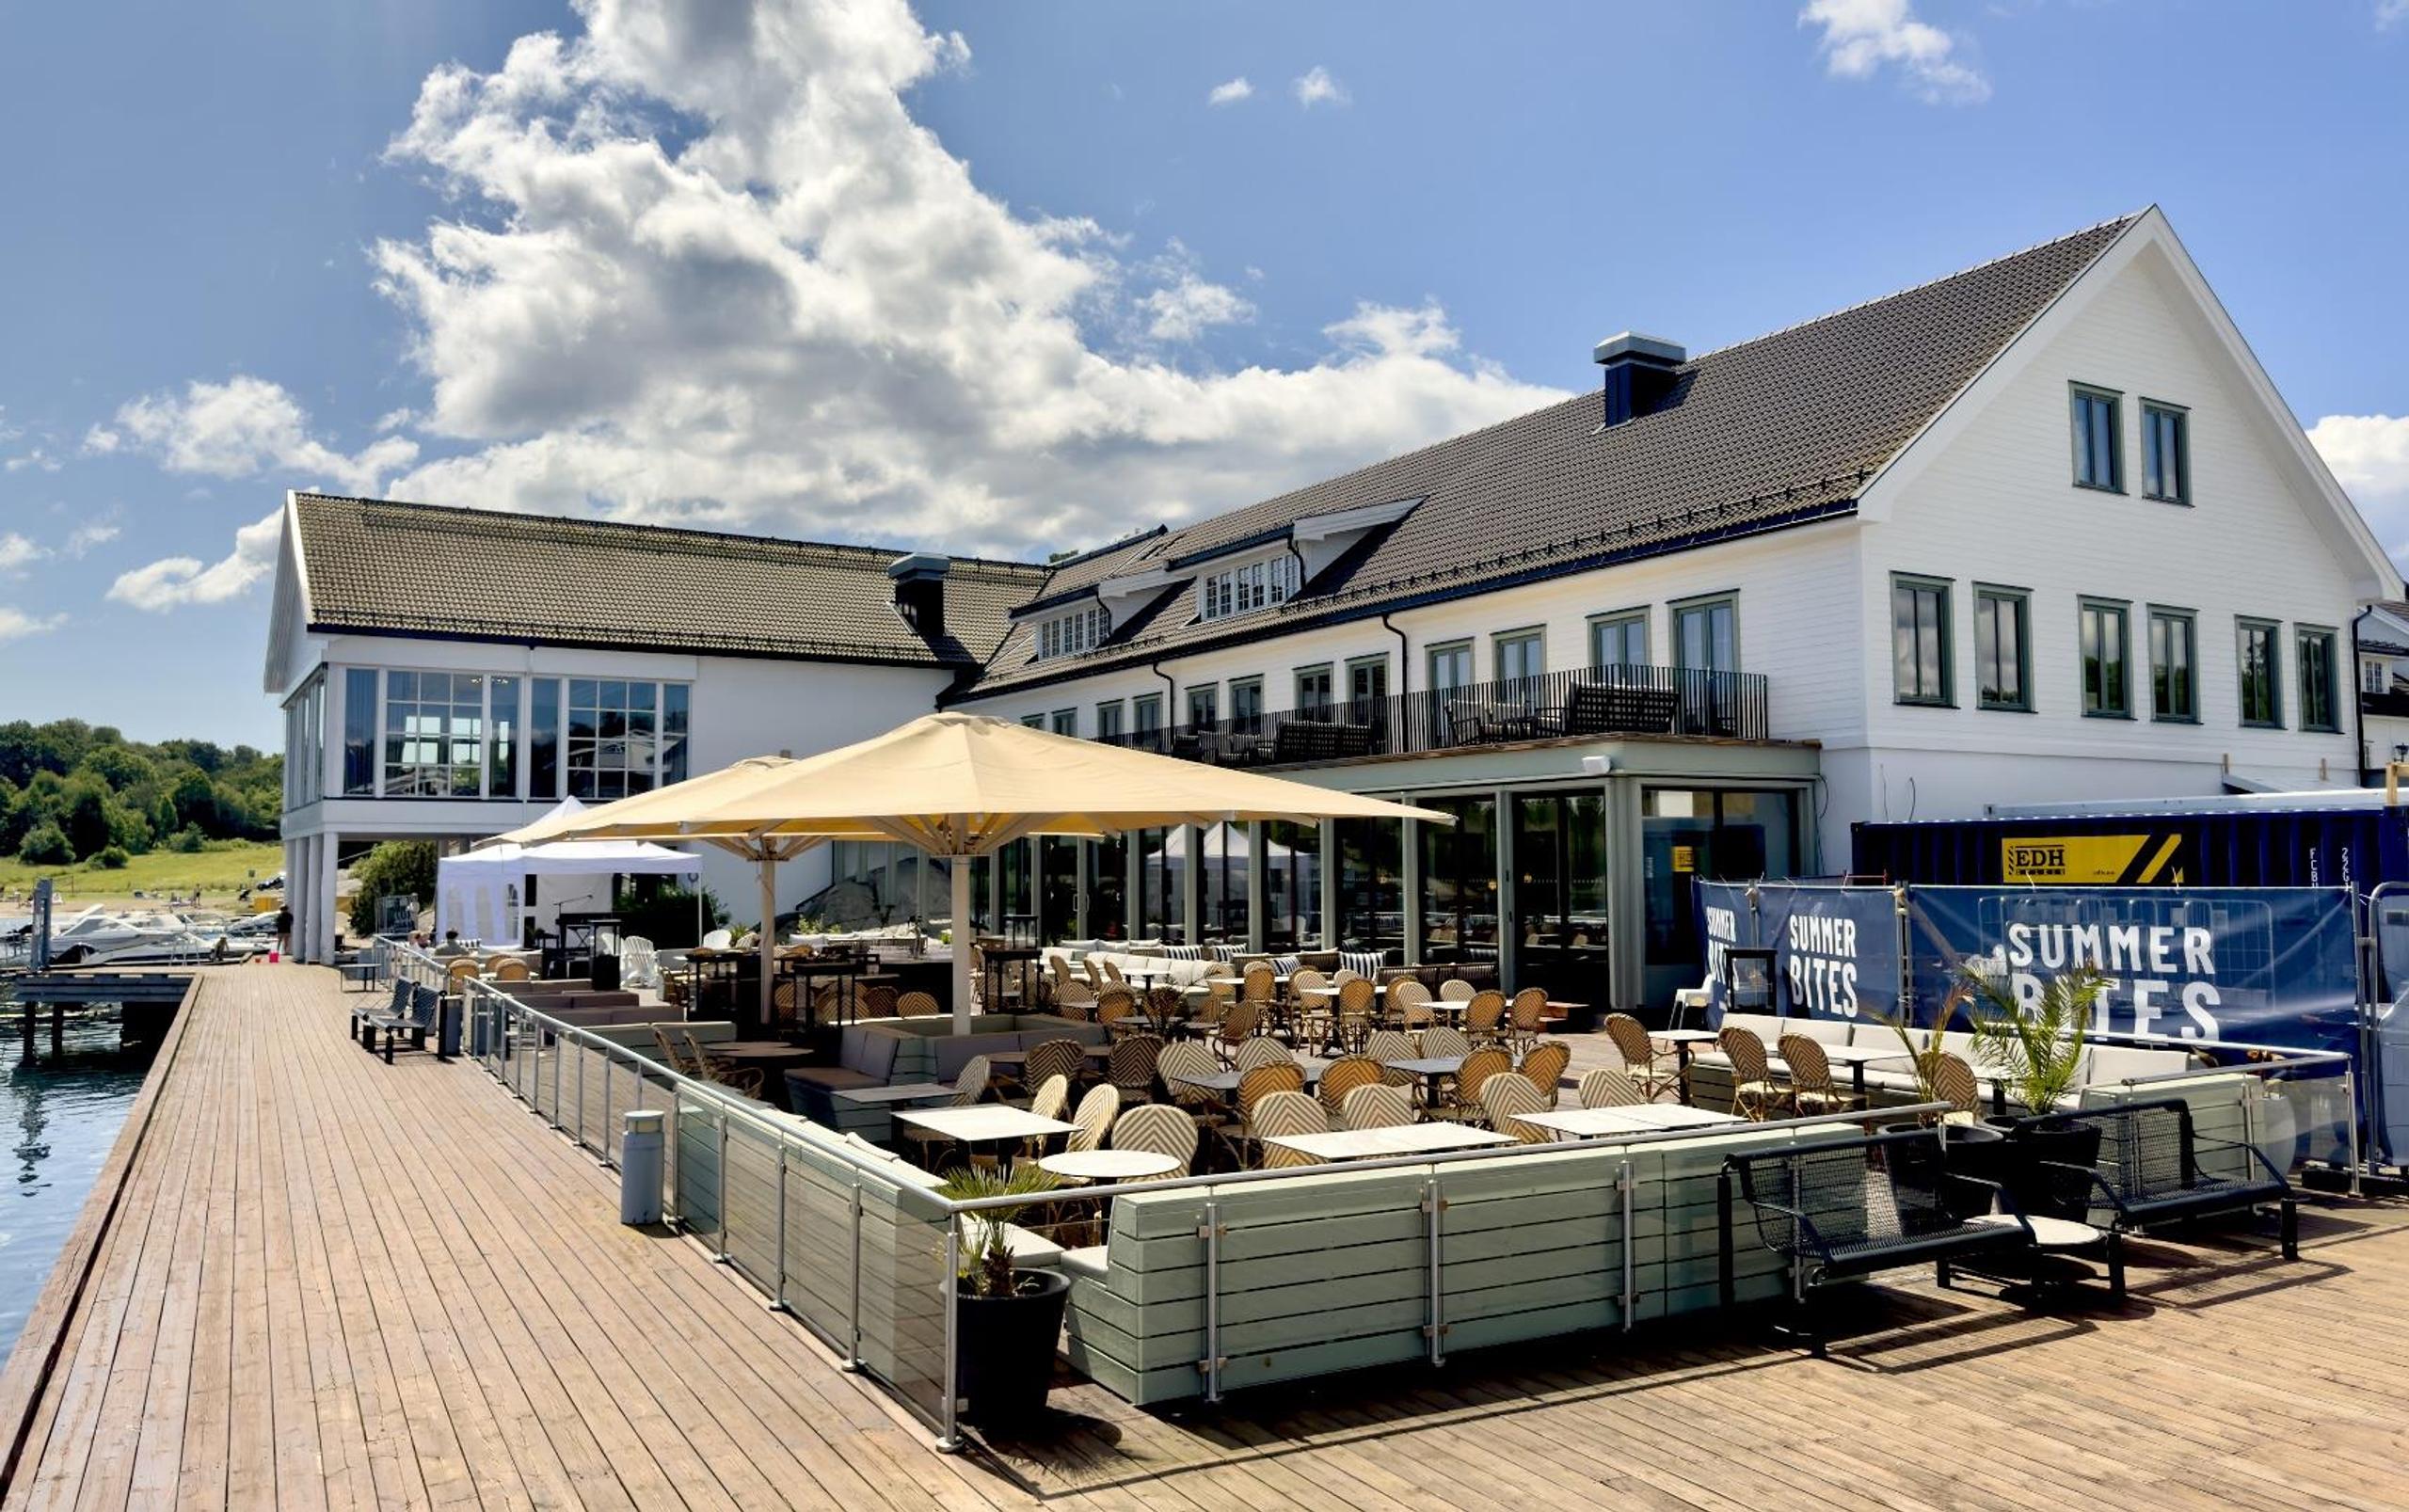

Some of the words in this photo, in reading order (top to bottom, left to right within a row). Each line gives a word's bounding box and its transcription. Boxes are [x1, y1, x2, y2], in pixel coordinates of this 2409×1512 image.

[2016, 849, 2066, 867] EDH
[1706, 906, 1737, 942] SUMMER
[1790, 914, 1857, 958] SUMMER
[2008, 922, 2215, 974] SUMMER
[1708, 939, 1739, 991] BITS
[1790, 954, 1859, 1018] BITES
